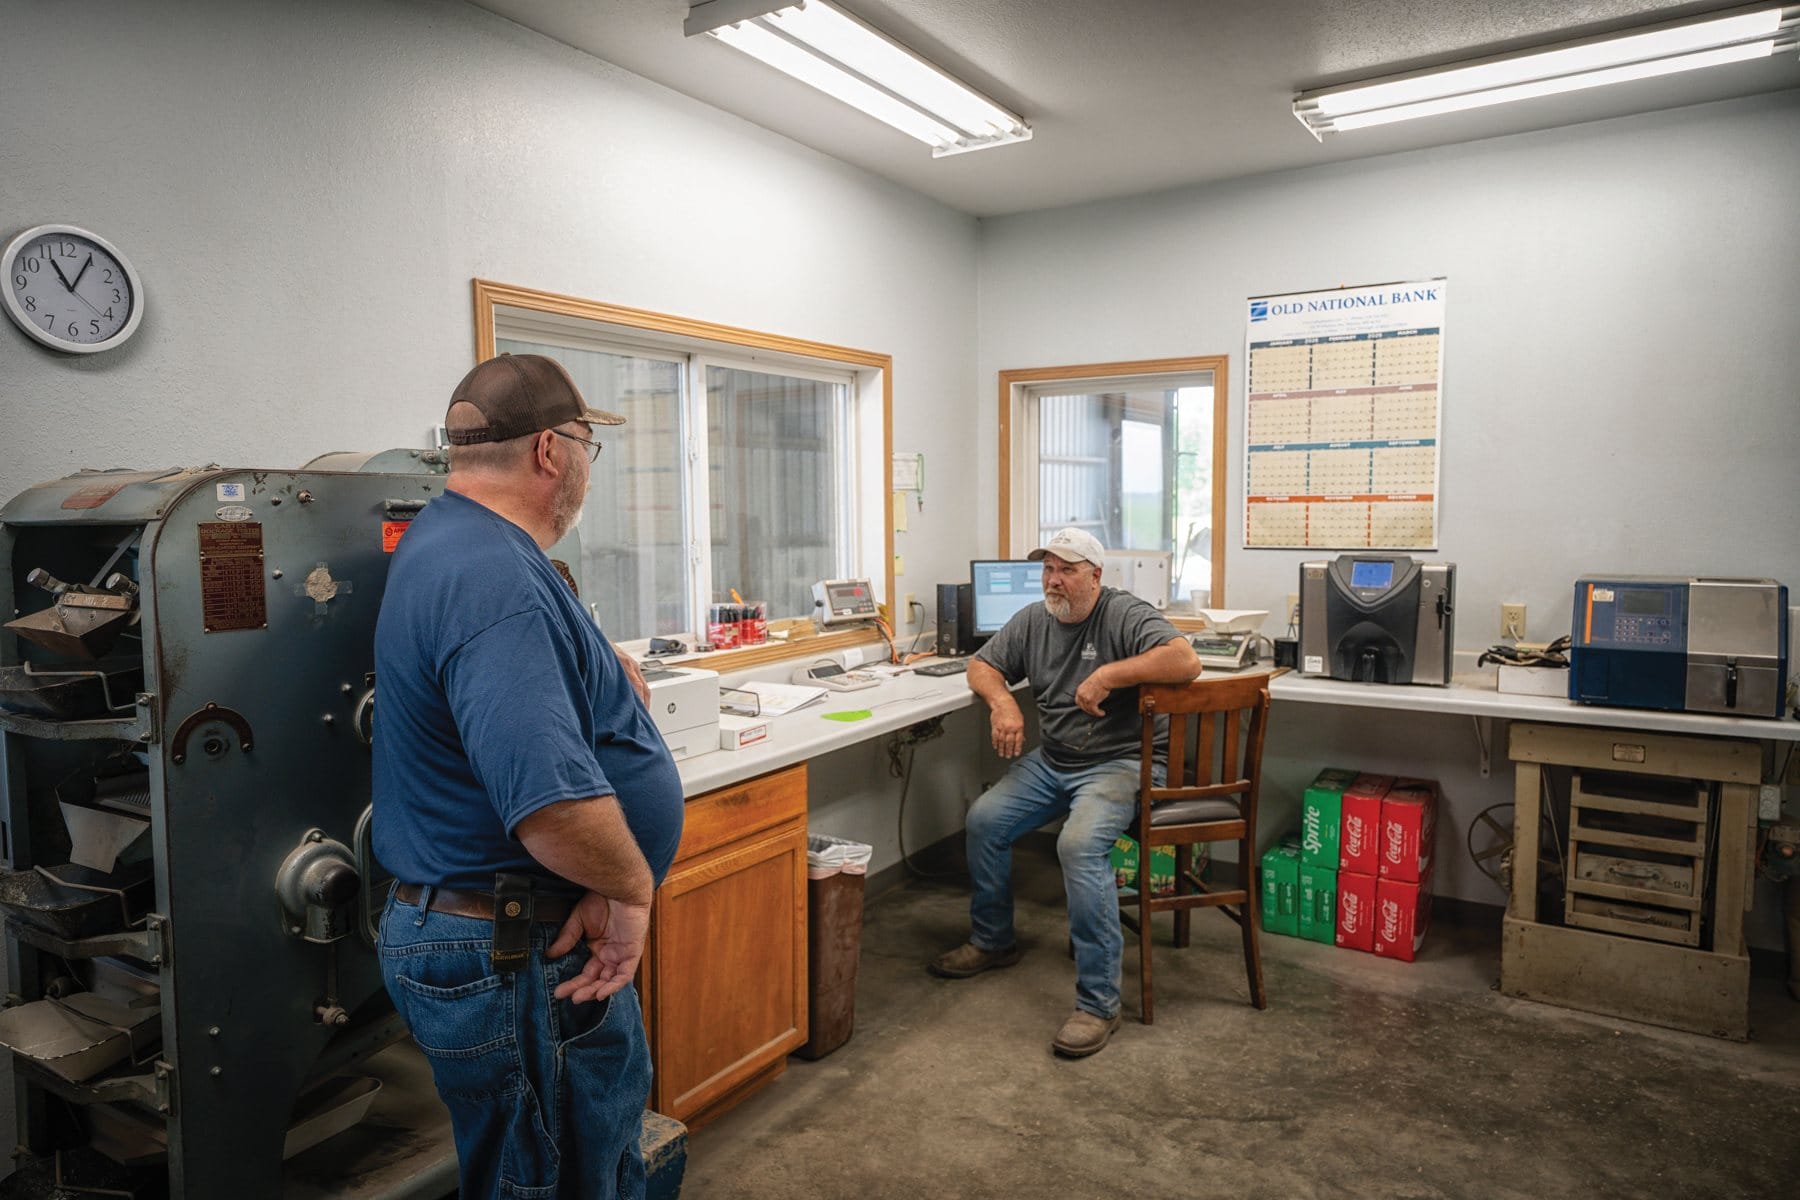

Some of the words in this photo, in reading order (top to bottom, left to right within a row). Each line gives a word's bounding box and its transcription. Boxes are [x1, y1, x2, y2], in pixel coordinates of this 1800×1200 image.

[39, 244, 52, 259] 11
[59, 242, 77, 258] 12
[21, 257, 40, 273] 10
[88, 252, 95, 266] 1
[16, 275, 27, 290] 9
[103, 269, 113, 284] 2
[25, 296, 36, 312] 8
[112, 289, 121, 303] 3
[1271, 302, 1303, 316] OLD
[1308, 294, 1388, 313] NATIONAL
[1392, 288, 1437, 305] BANK
[44, 314, 55, 330] 7
[103, 307, 114, 321] 4
[68, 322, 79, 336] 6
[90, 320, 100, 335] 5
[1303, 805, 1322, 855] Sprite
[1345, 813, 1362, 857] Coca-Cola
[1385, 820, 1403, 864] Coca-Cola
[1341, 889, 1358, 934] Coca-Cola
[1381, 899, 1398, 943] Coca-Cola
